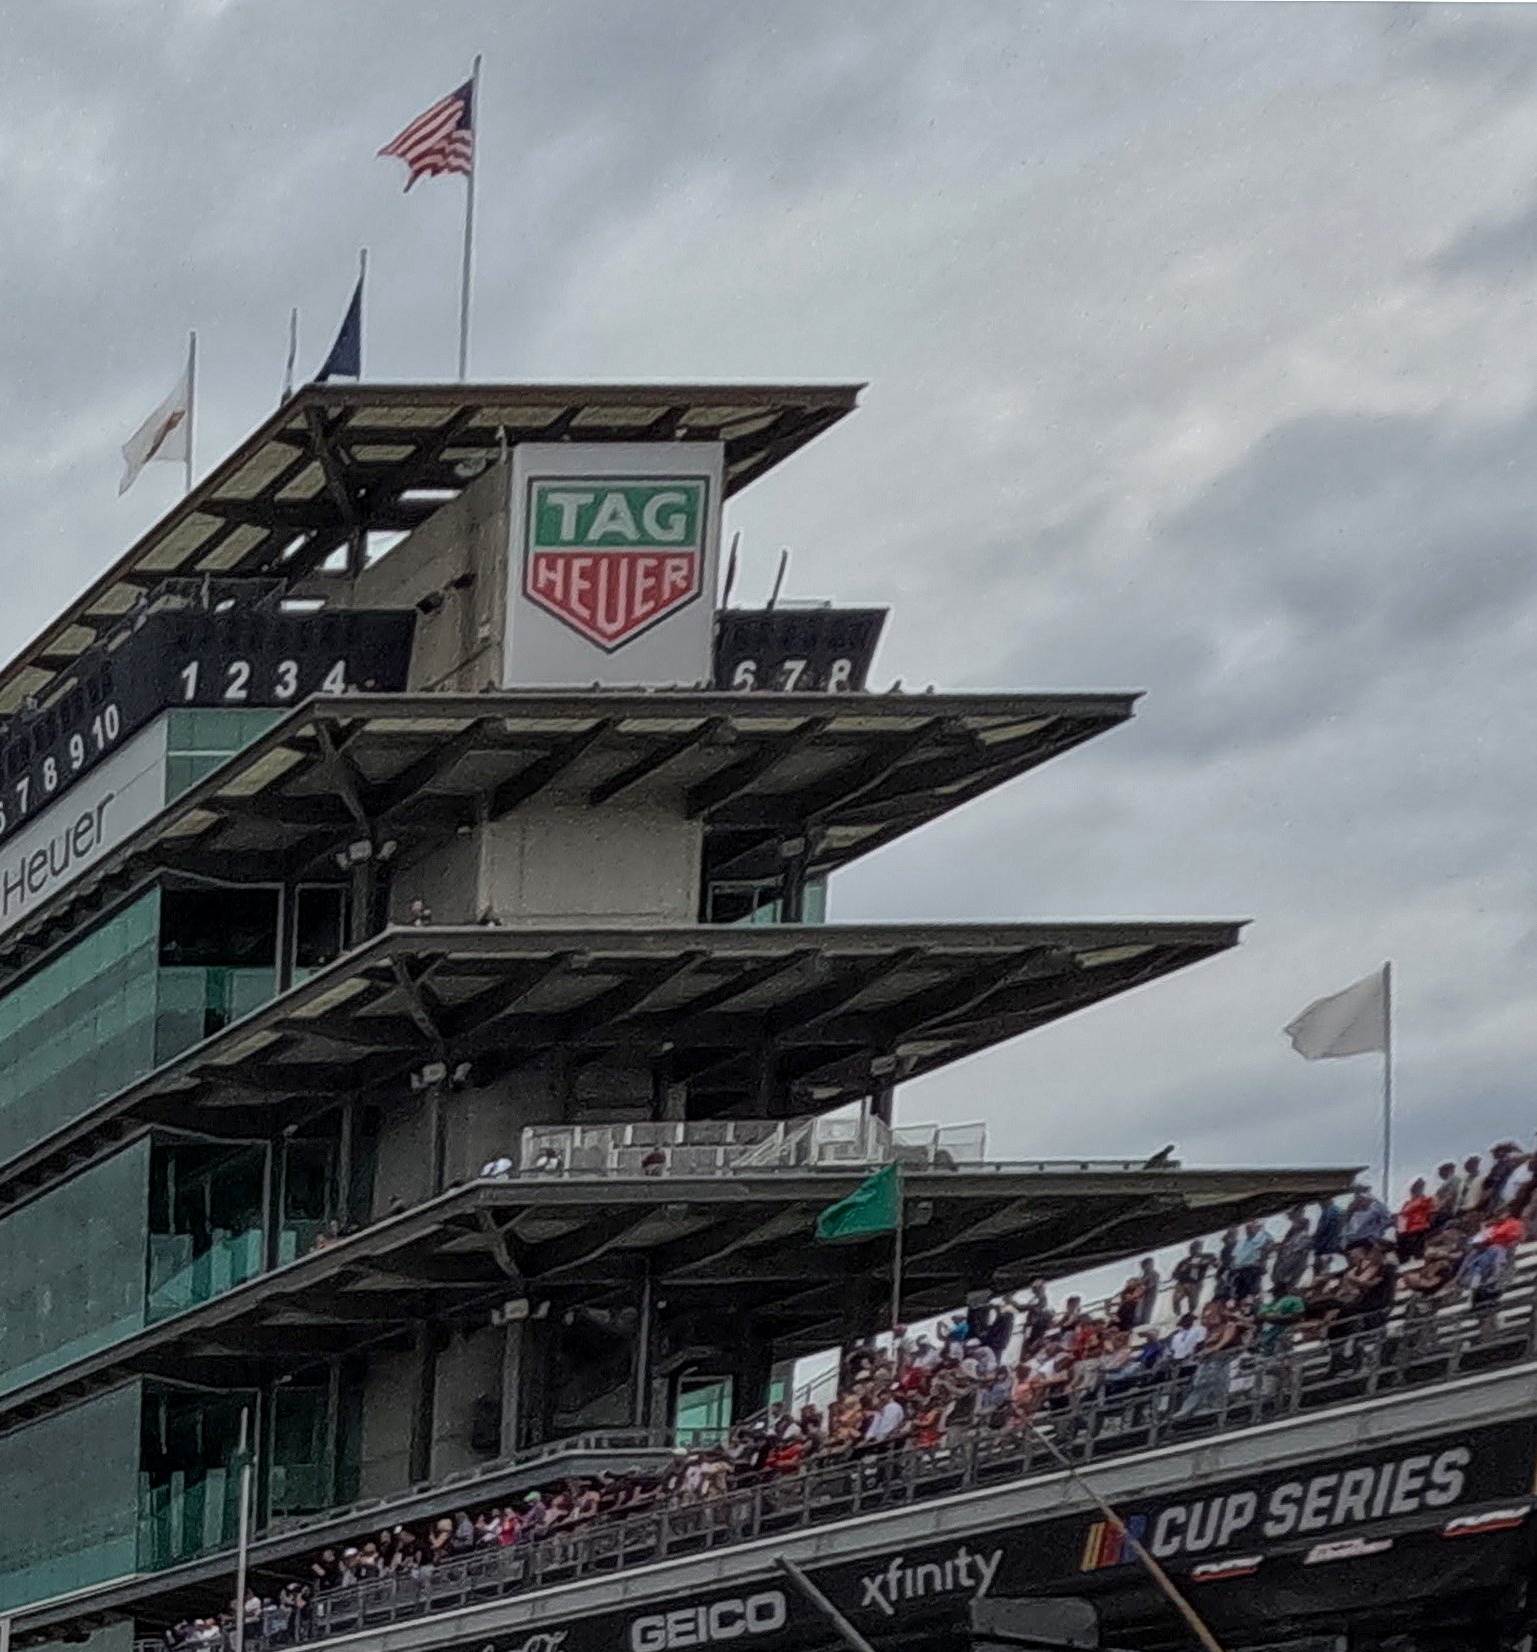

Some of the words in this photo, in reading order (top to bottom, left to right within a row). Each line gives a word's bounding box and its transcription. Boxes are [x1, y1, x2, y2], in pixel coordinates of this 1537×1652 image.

[546, 491, 688, 542] TAG
[537, 556, 688, 635] HEUER
[180, 660, 199, 701] 1
[224, 659, 251, 699] 2
[274, 659, 299, 699] 3
[323, 659, 346, 695] 4
[732, 659, 757, 693] 6
[782, 659, 807, 693] 7
[16, 776, 30, 814] 7
[43, 756, 58, 792] 8
[69, 733, 84, 770] 9
[91, 703, 120, 750] 10
[1151, 1490, 1258, 1559] CUP
[1262, 1446, 1473, 1538] SERIES
[861, 1547, 1004, 1616] xfinity
